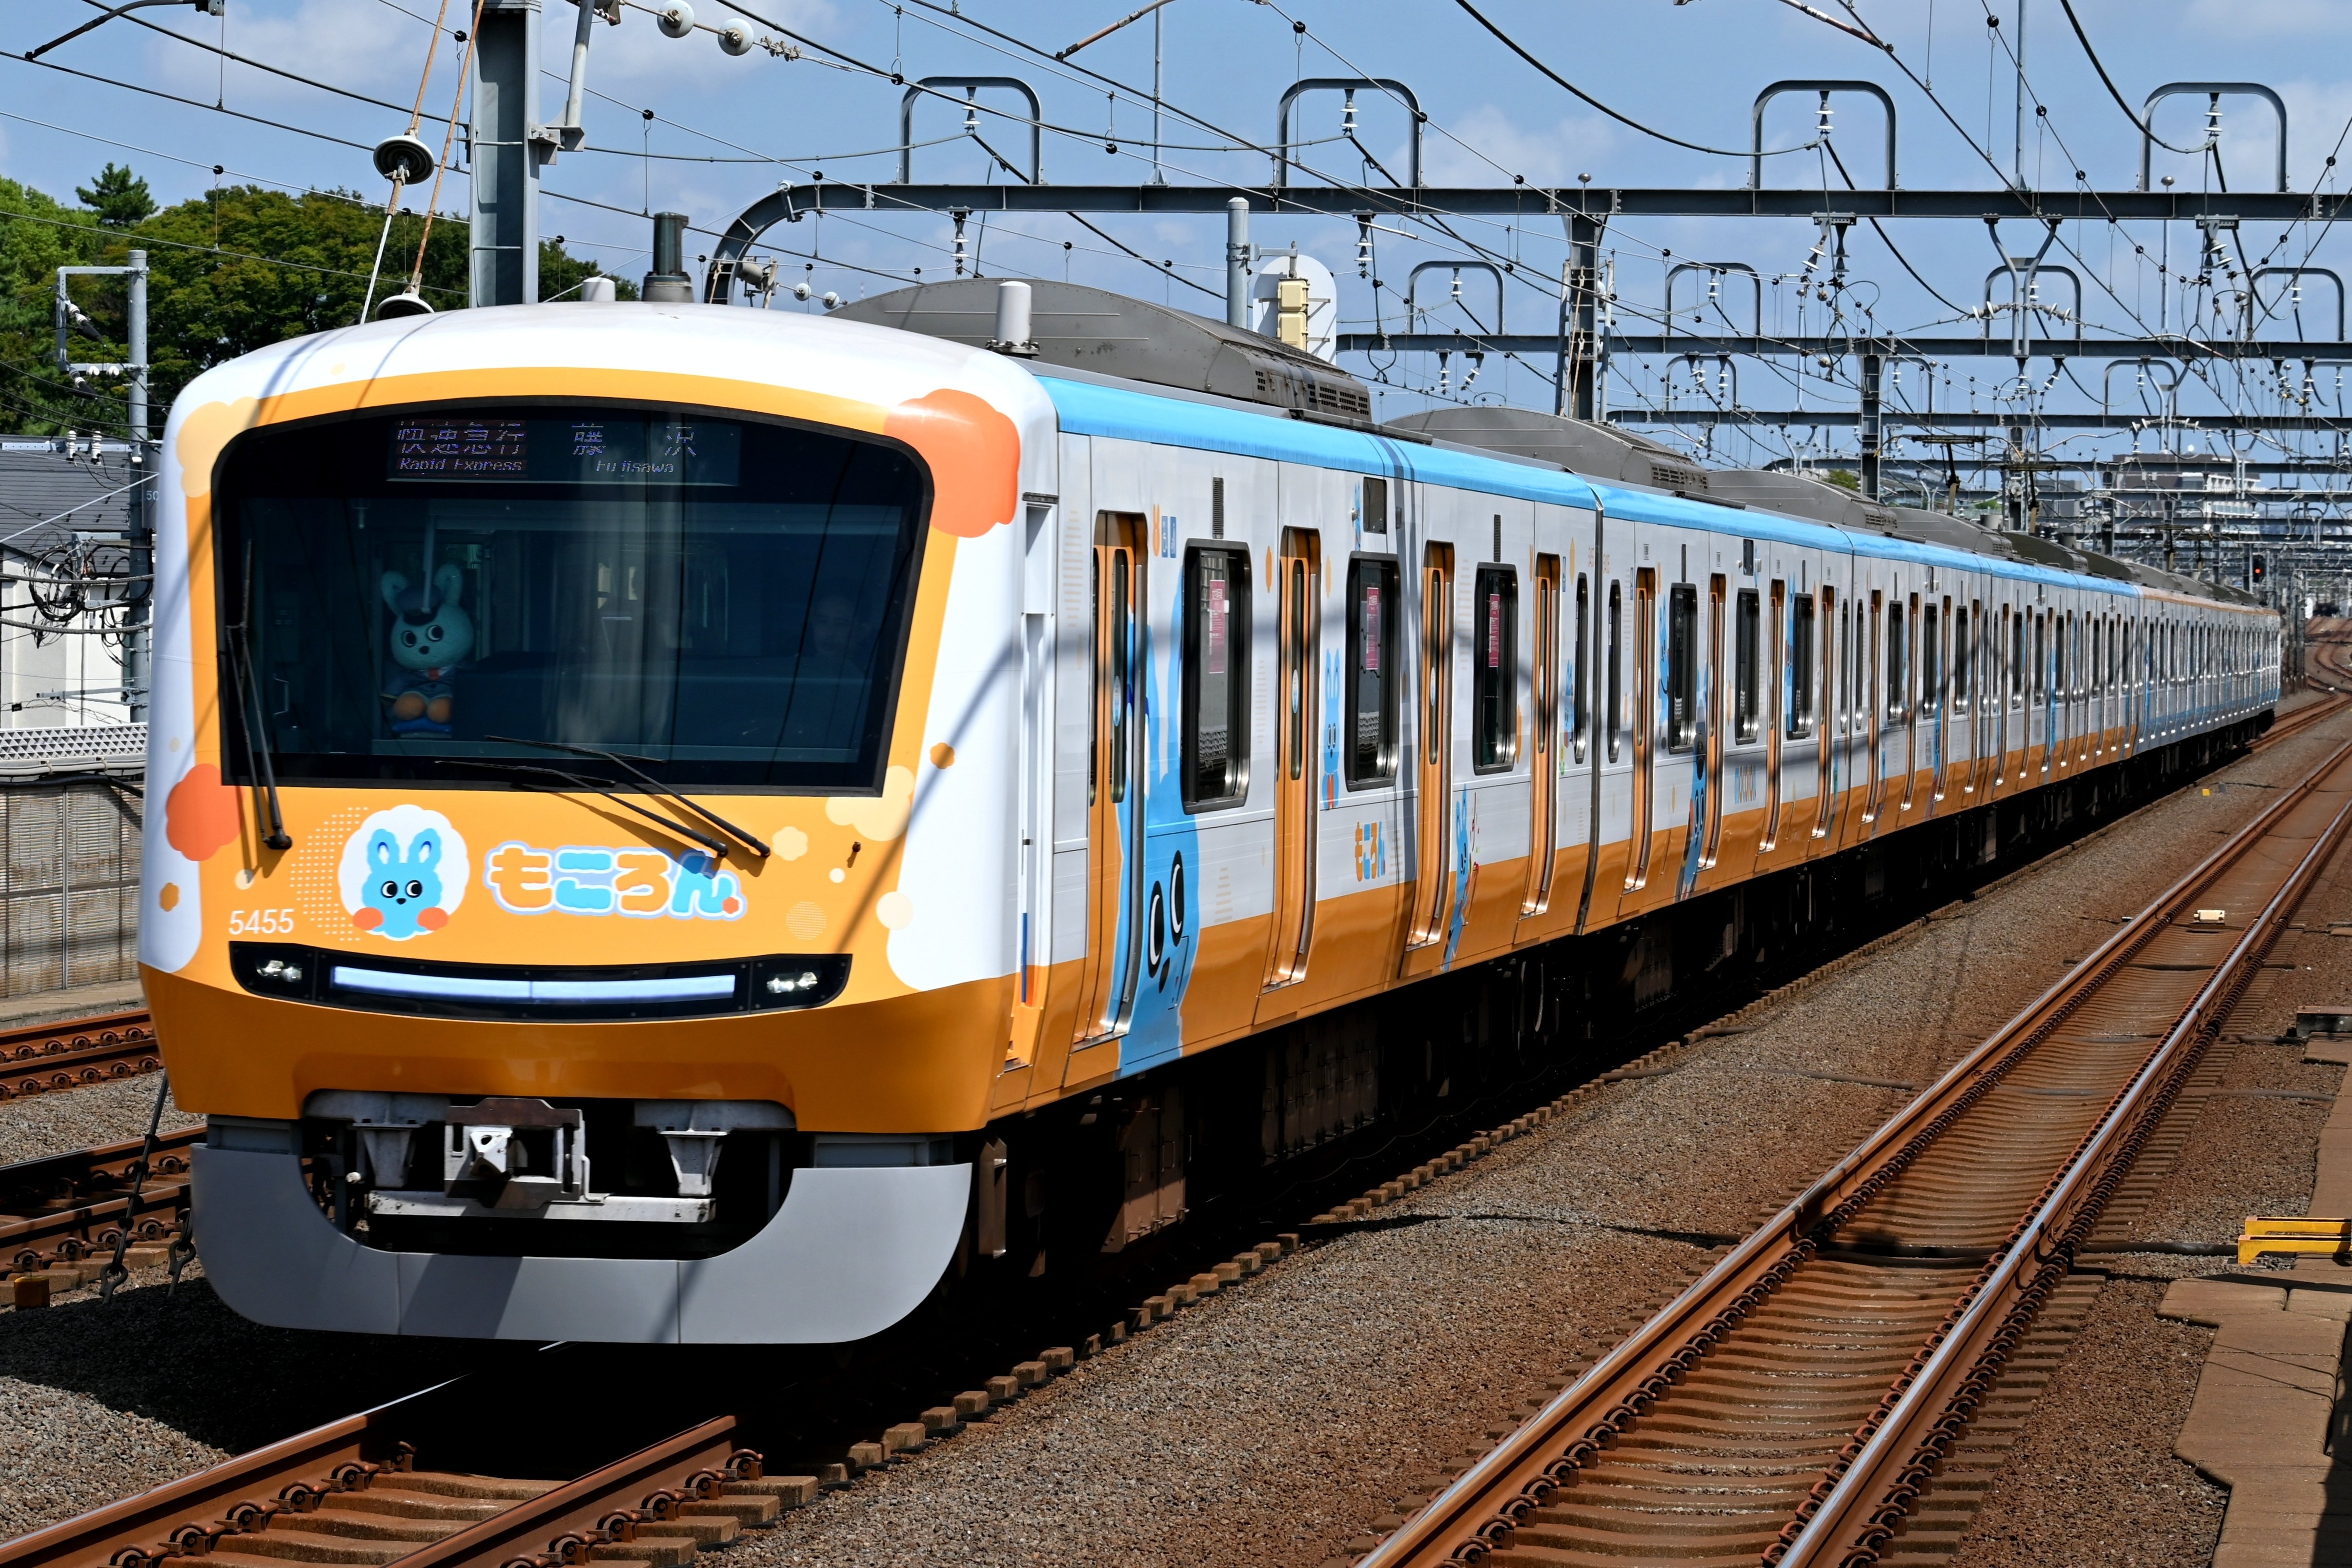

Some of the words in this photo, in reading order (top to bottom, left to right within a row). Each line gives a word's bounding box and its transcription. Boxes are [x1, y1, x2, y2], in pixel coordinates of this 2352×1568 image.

[399, 458, 446, 475] Rapid
[454, 459, 523, 475] Express
[596, 460, 674, 477] Fujisawa
[1355, 821, 1386, 882] もころん
[487, 843, 744, 919] もころん
[228, 908, 295, 935] 5455
